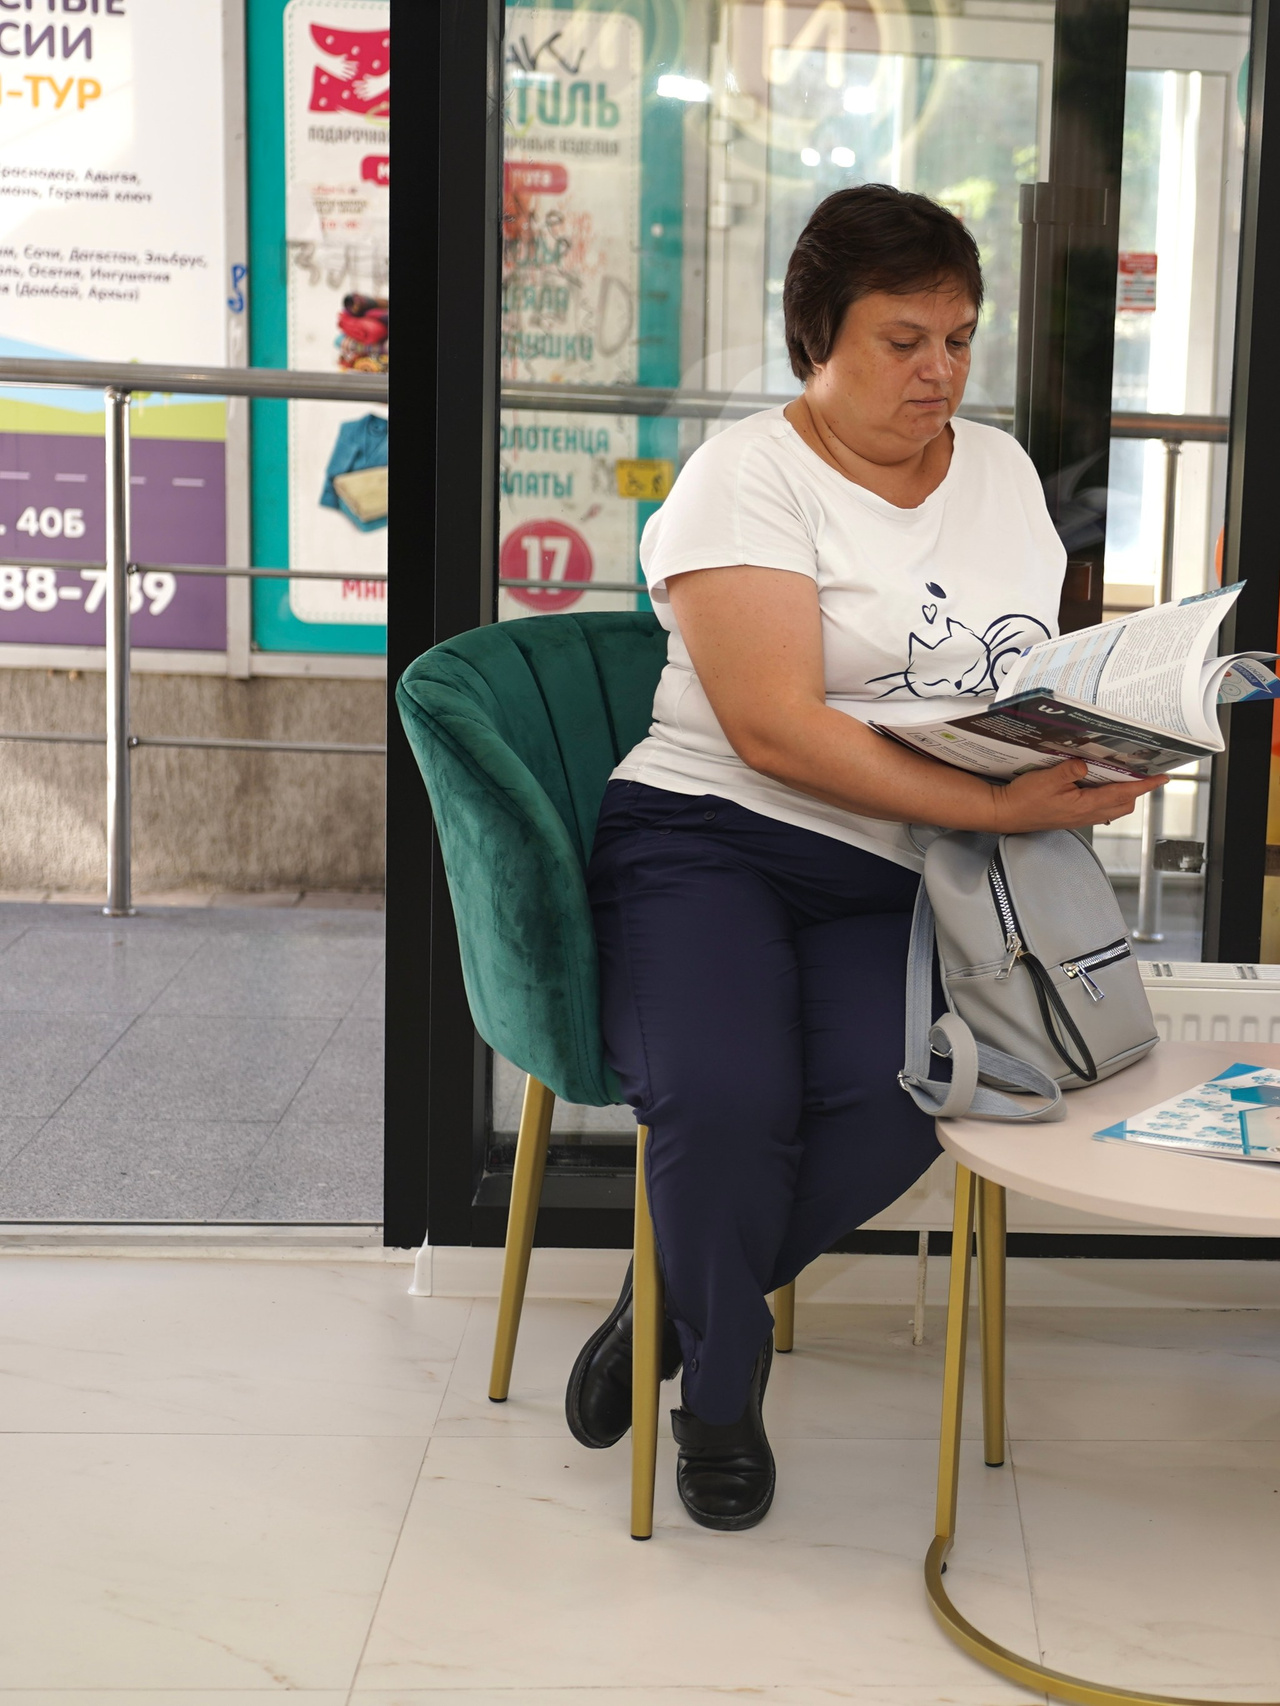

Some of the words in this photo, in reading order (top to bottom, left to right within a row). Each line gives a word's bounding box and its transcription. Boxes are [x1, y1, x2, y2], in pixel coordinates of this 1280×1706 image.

[0, 22, 92, 60] СИИ
[0, 75, 102, 110] -ТУР
[48, 185, 109, 202] Горячий
[114, 191, 152, 202] ключ
[16, 506, 86, 539] 40Б
[521, 536, 572, 594] 17
